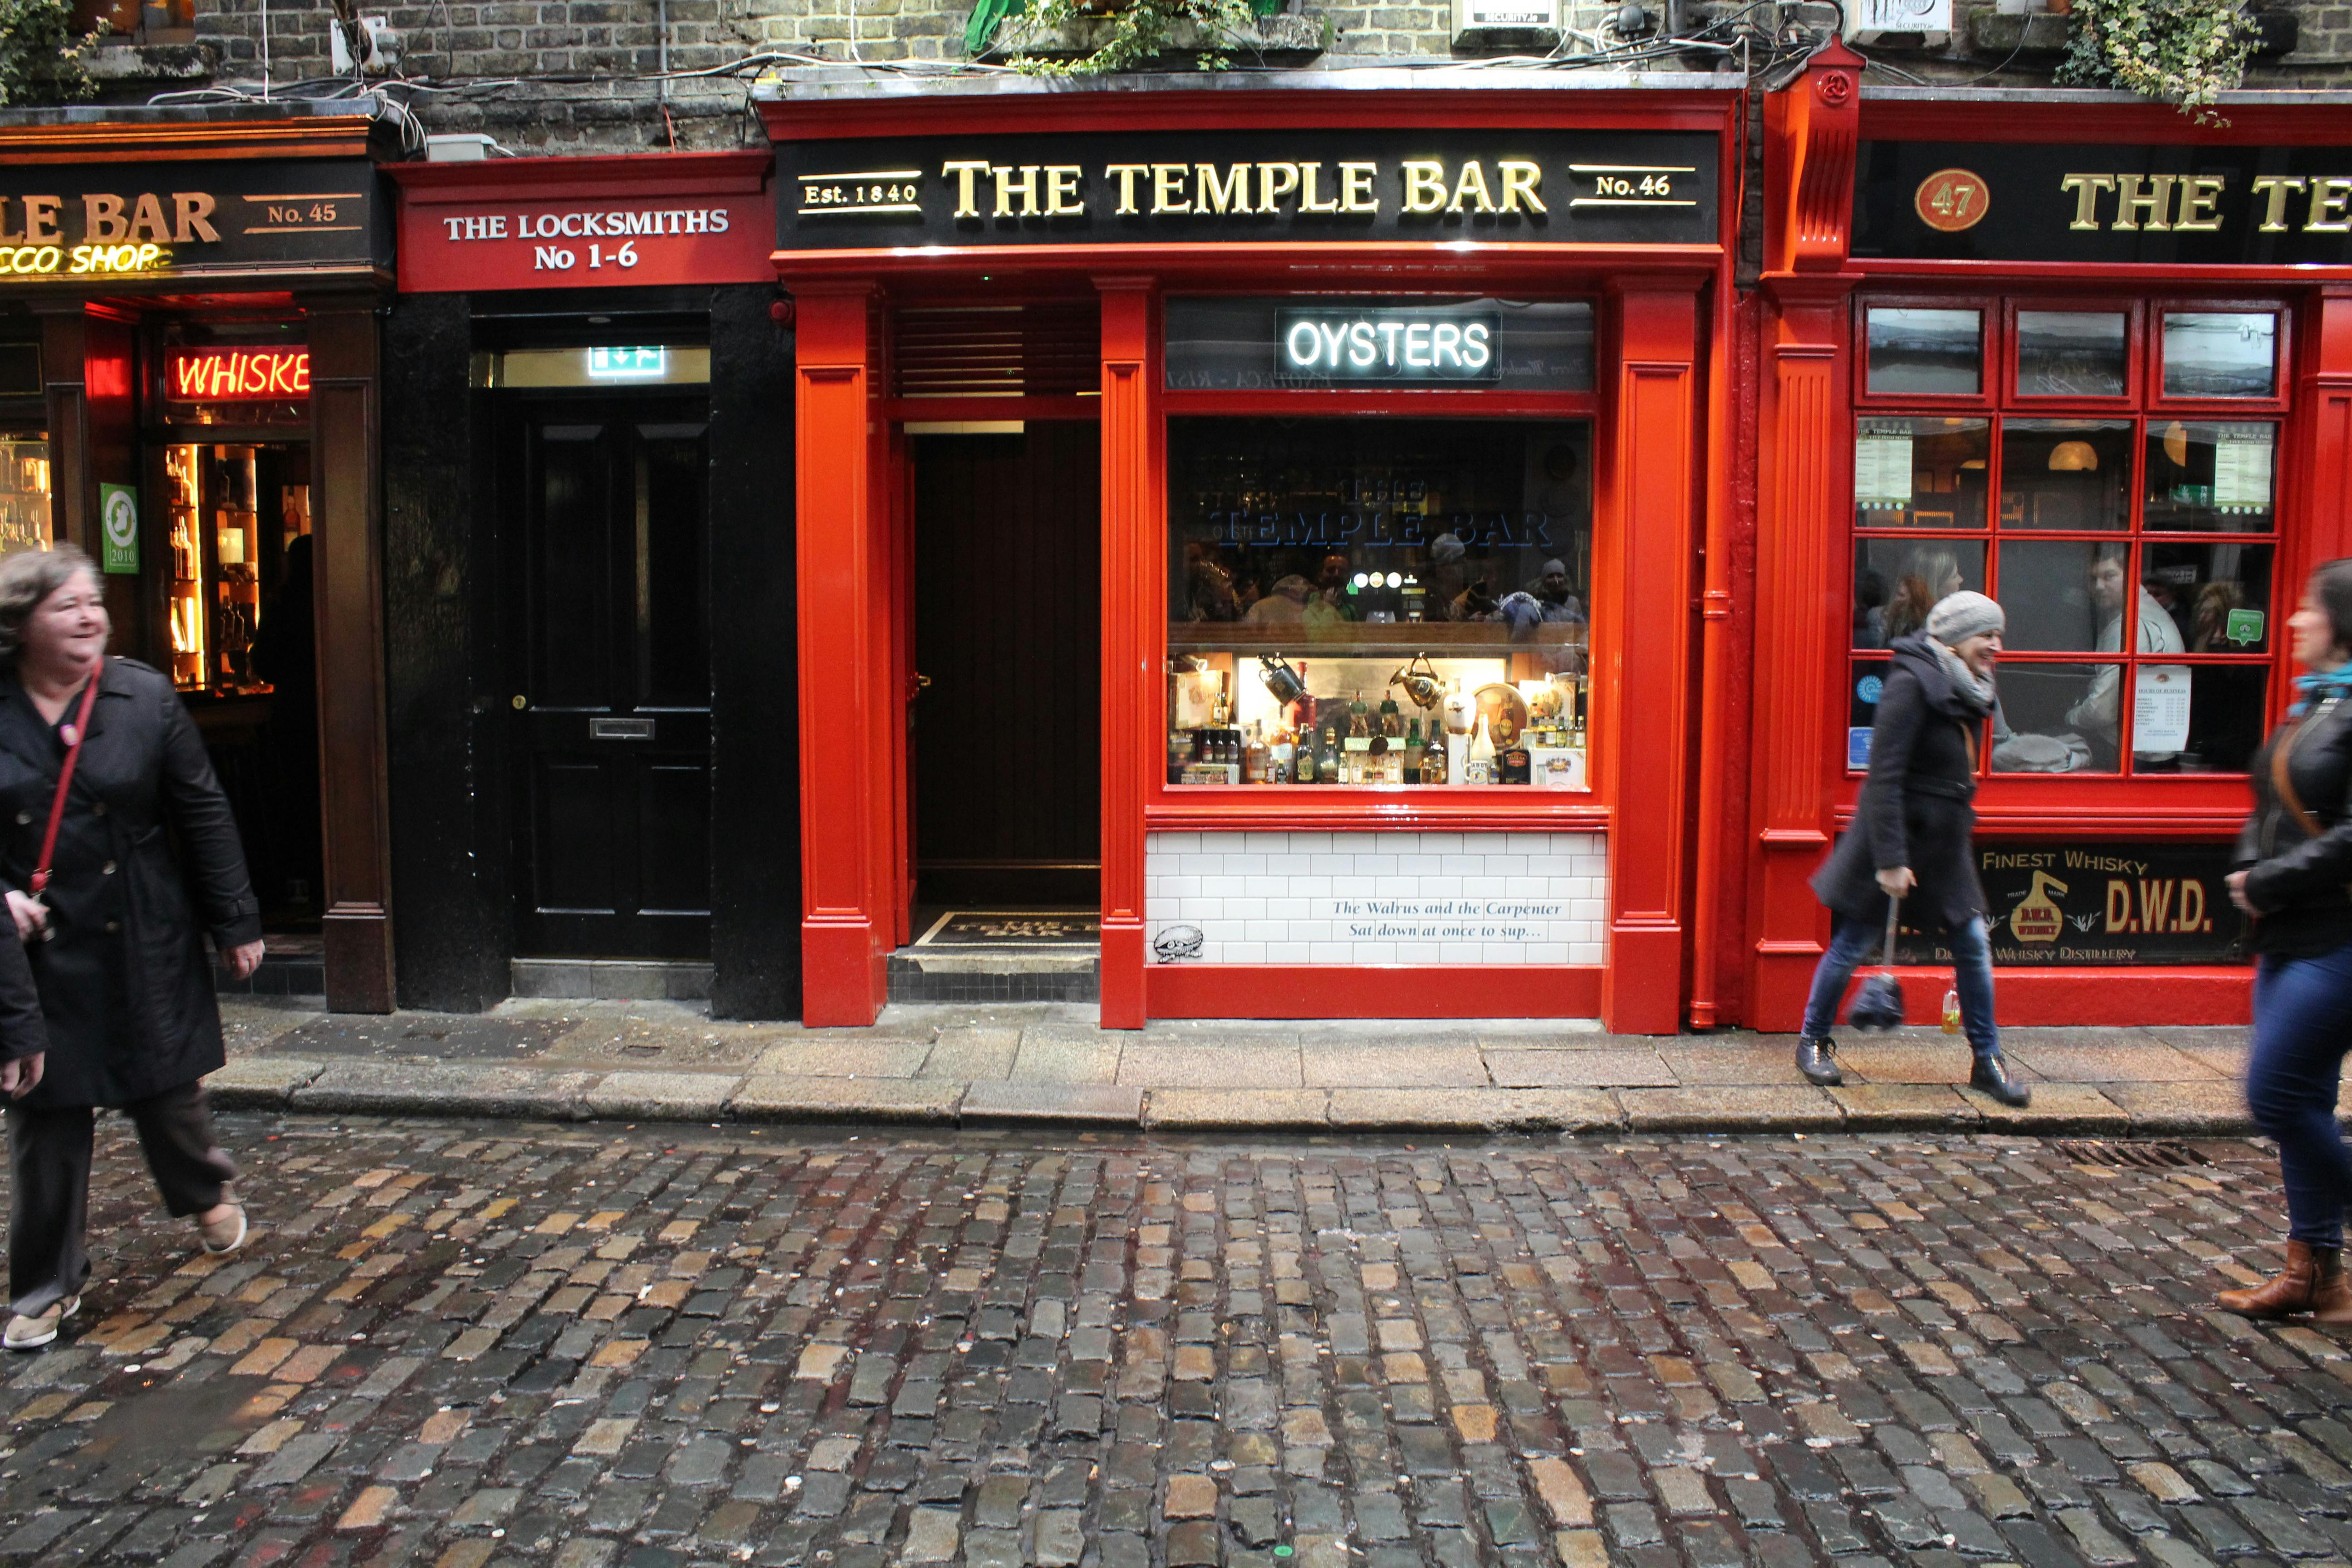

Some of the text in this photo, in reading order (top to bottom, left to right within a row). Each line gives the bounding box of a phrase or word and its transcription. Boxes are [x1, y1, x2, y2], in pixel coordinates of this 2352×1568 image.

[1485, 13, 1539, 22] SECURITY.ie
[804, 184, 917, 204] Est. 1840
[941, 160, 1547, 218] THE TEMPLE BAR
[1596, 175, 1671, 196] No. 46
[1930, 182, 1977, 217] 47
[2060, 173, 2352, 232] THE TE
[81, 192, 221, 245] BAR
[268, 203, 337, 223] No. 45
[444, 208, 730, 240] THE LOCKSMITHS
[70, 243, 159, 274] SHOP
[534, 240, 638, 270] No 1-6
[1289, 321, 1490, 368] OYSTERS
[112, 549, 135, 562] 2010
[1982, 850, 2150, 876] FINEST WHISKY
[2007, 889, 2066, 899] TRADE MARK
[2105, 878, 2213, 934] D.W.D.
[1333, 901, 1563, 918] The Walrus and the Carpenter
[1348, 923, 1541, 940] Sat down at once to sup...
[1995, 946, 2136, 961] WHISKY DISTILLERY
